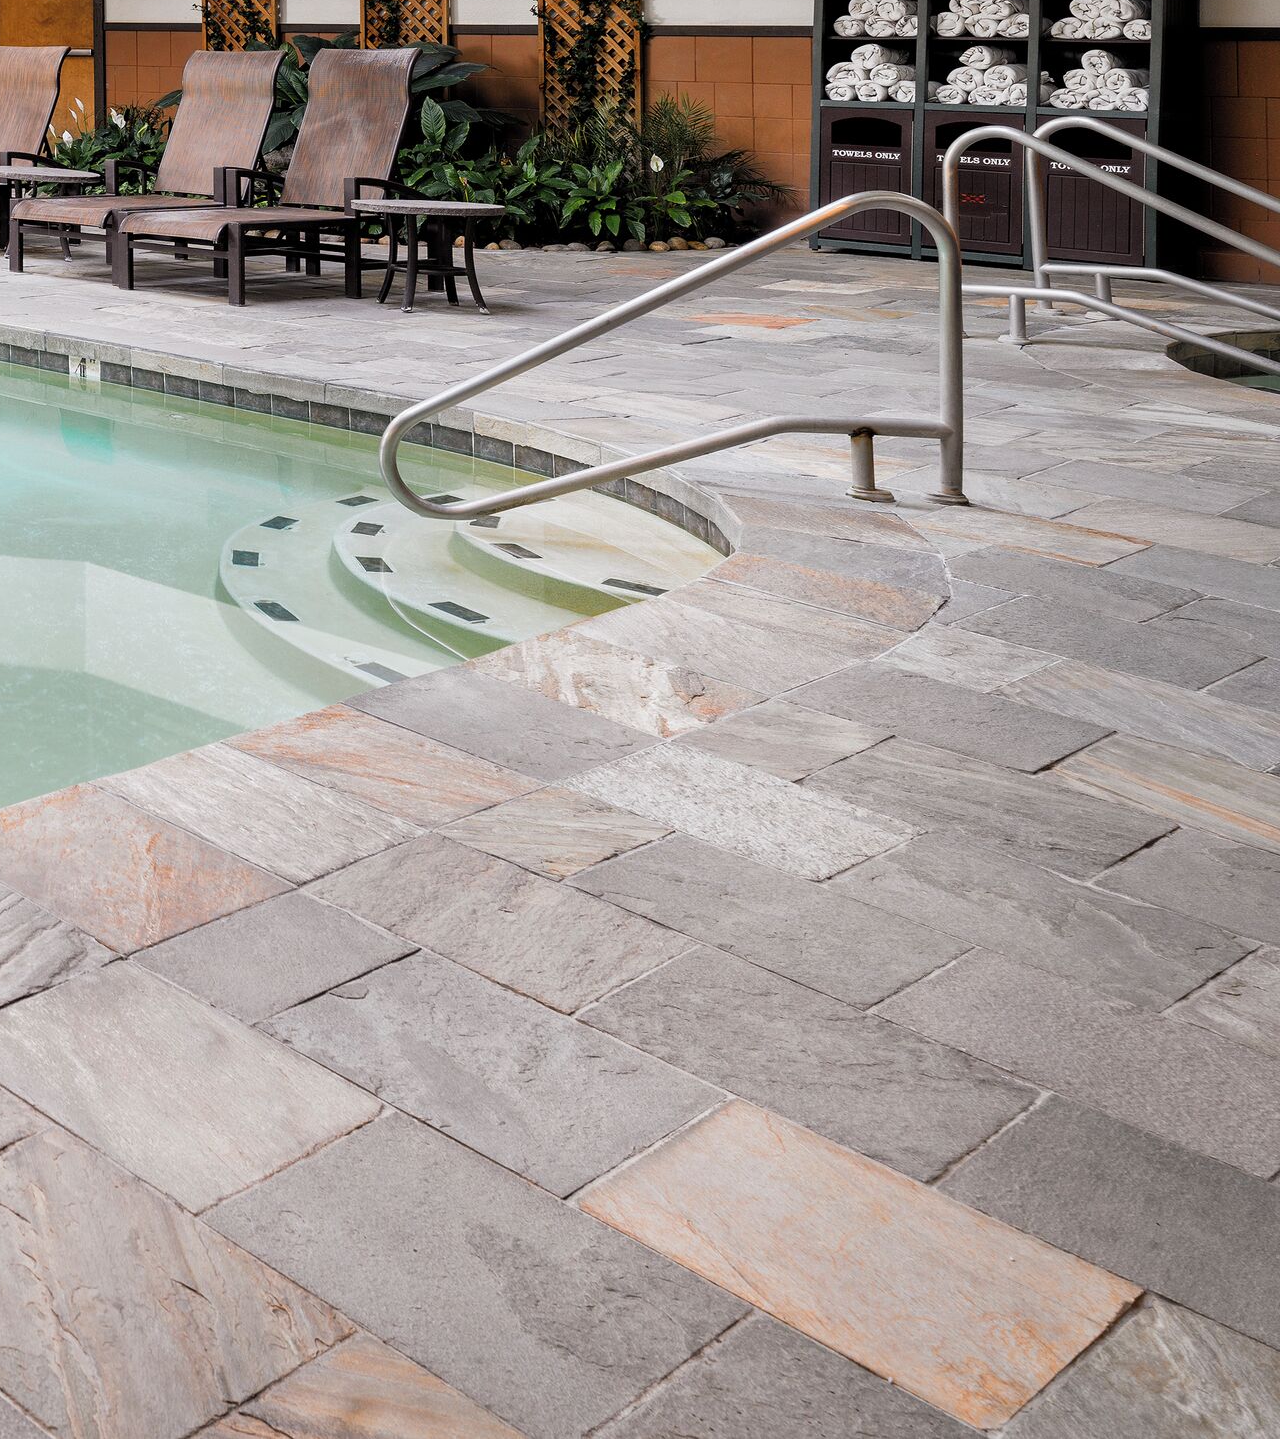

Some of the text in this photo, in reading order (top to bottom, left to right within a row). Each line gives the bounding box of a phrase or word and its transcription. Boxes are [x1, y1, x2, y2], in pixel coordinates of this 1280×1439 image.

[832, 149, 900, 160] TOWELS ONLY
[936, 154, 1011, 166] TELS ONLY
[1100, 164, 1131, 174] ONLY
